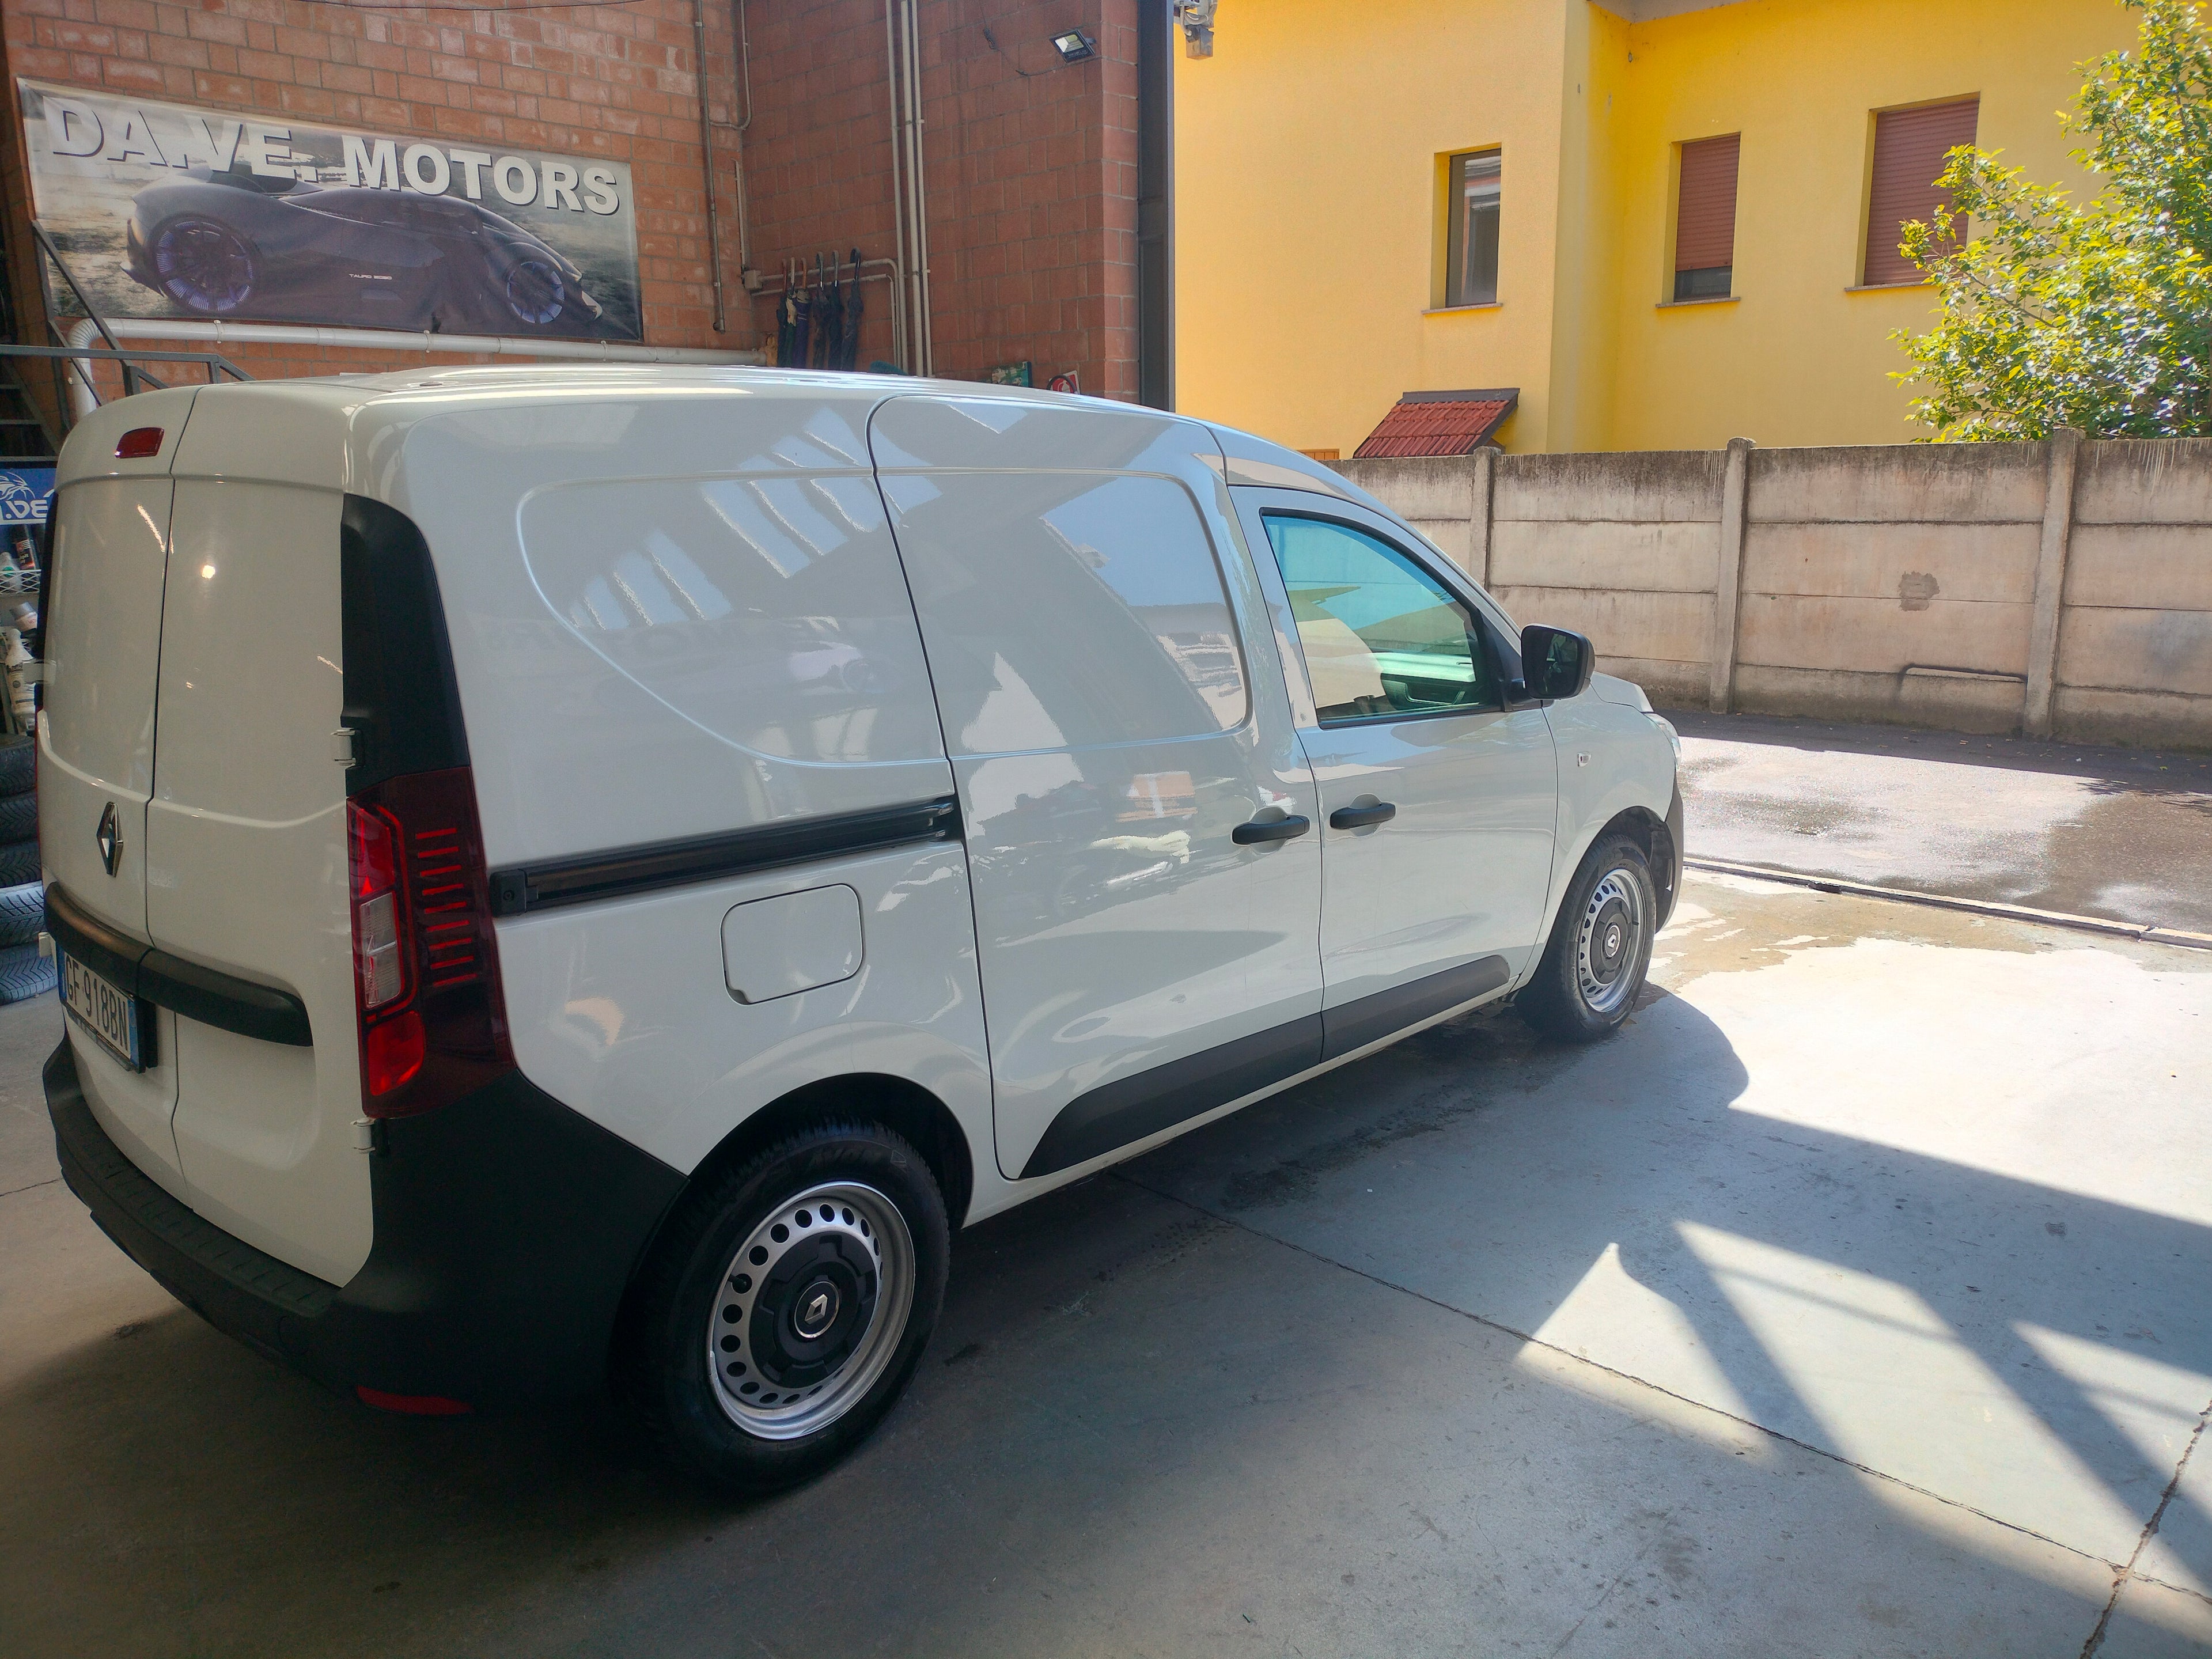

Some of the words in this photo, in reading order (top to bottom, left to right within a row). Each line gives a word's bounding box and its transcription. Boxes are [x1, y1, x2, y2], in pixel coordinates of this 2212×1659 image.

[342, 135, 620, 216] MOTORS
[66, 955, 79, 1006] GF
[84, 970, 128, 1051] 918BN
